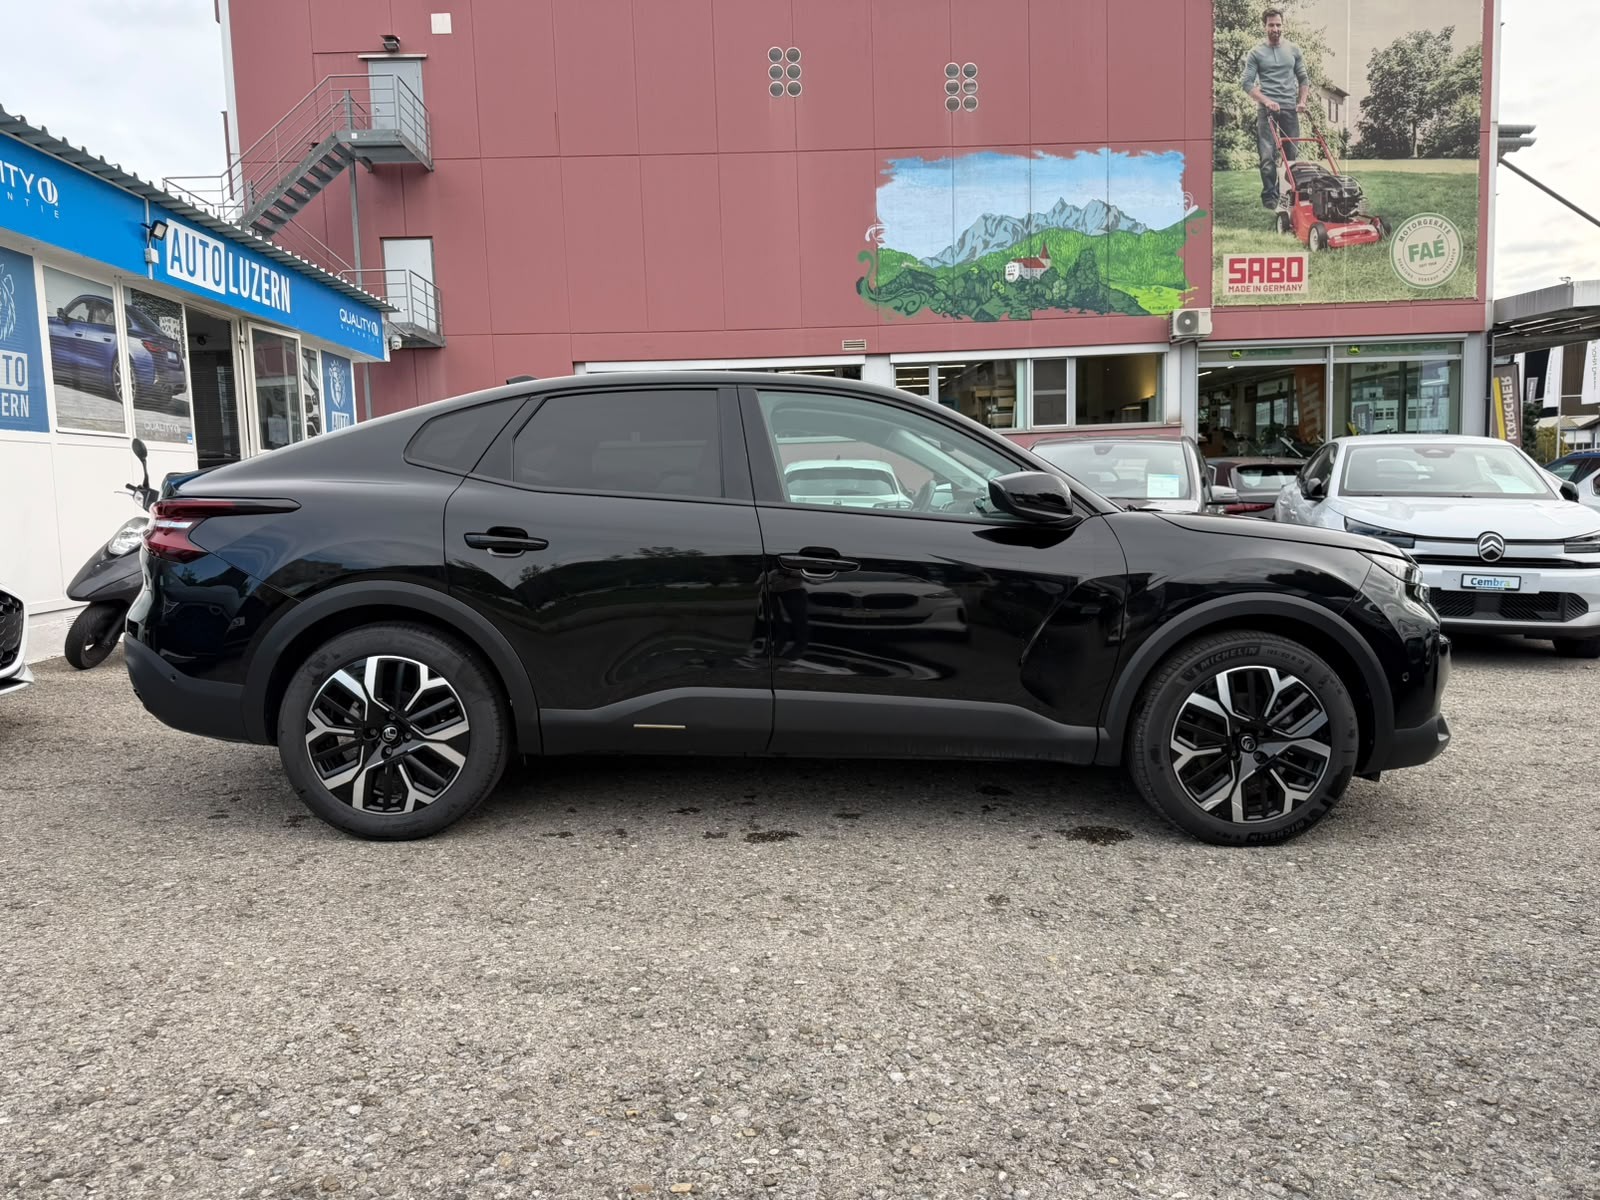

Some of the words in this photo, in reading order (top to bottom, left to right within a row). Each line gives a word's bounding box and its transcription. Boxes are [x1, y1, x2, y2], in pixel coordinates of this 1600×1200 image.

[1398, 218, 1452, 243] MOTORGERÄTE
[1407, 233, 1446, 263] FAÉ
[170, 227, 223, 288] AUTO
[228, 251, 291, 314] LUZERN
[1229, 256, 1304, 284] SABO
[1228, 285, 1252, 293] MADE
[1253, 285, 1262, 293] IN
[1262, 283, 1303, 293] GERMANY
[339, 308, 371, 333] QUALITY
[1470, 577, 1511, 587] Cembra
[1201, 647, 1258, 670] MICHELIN
